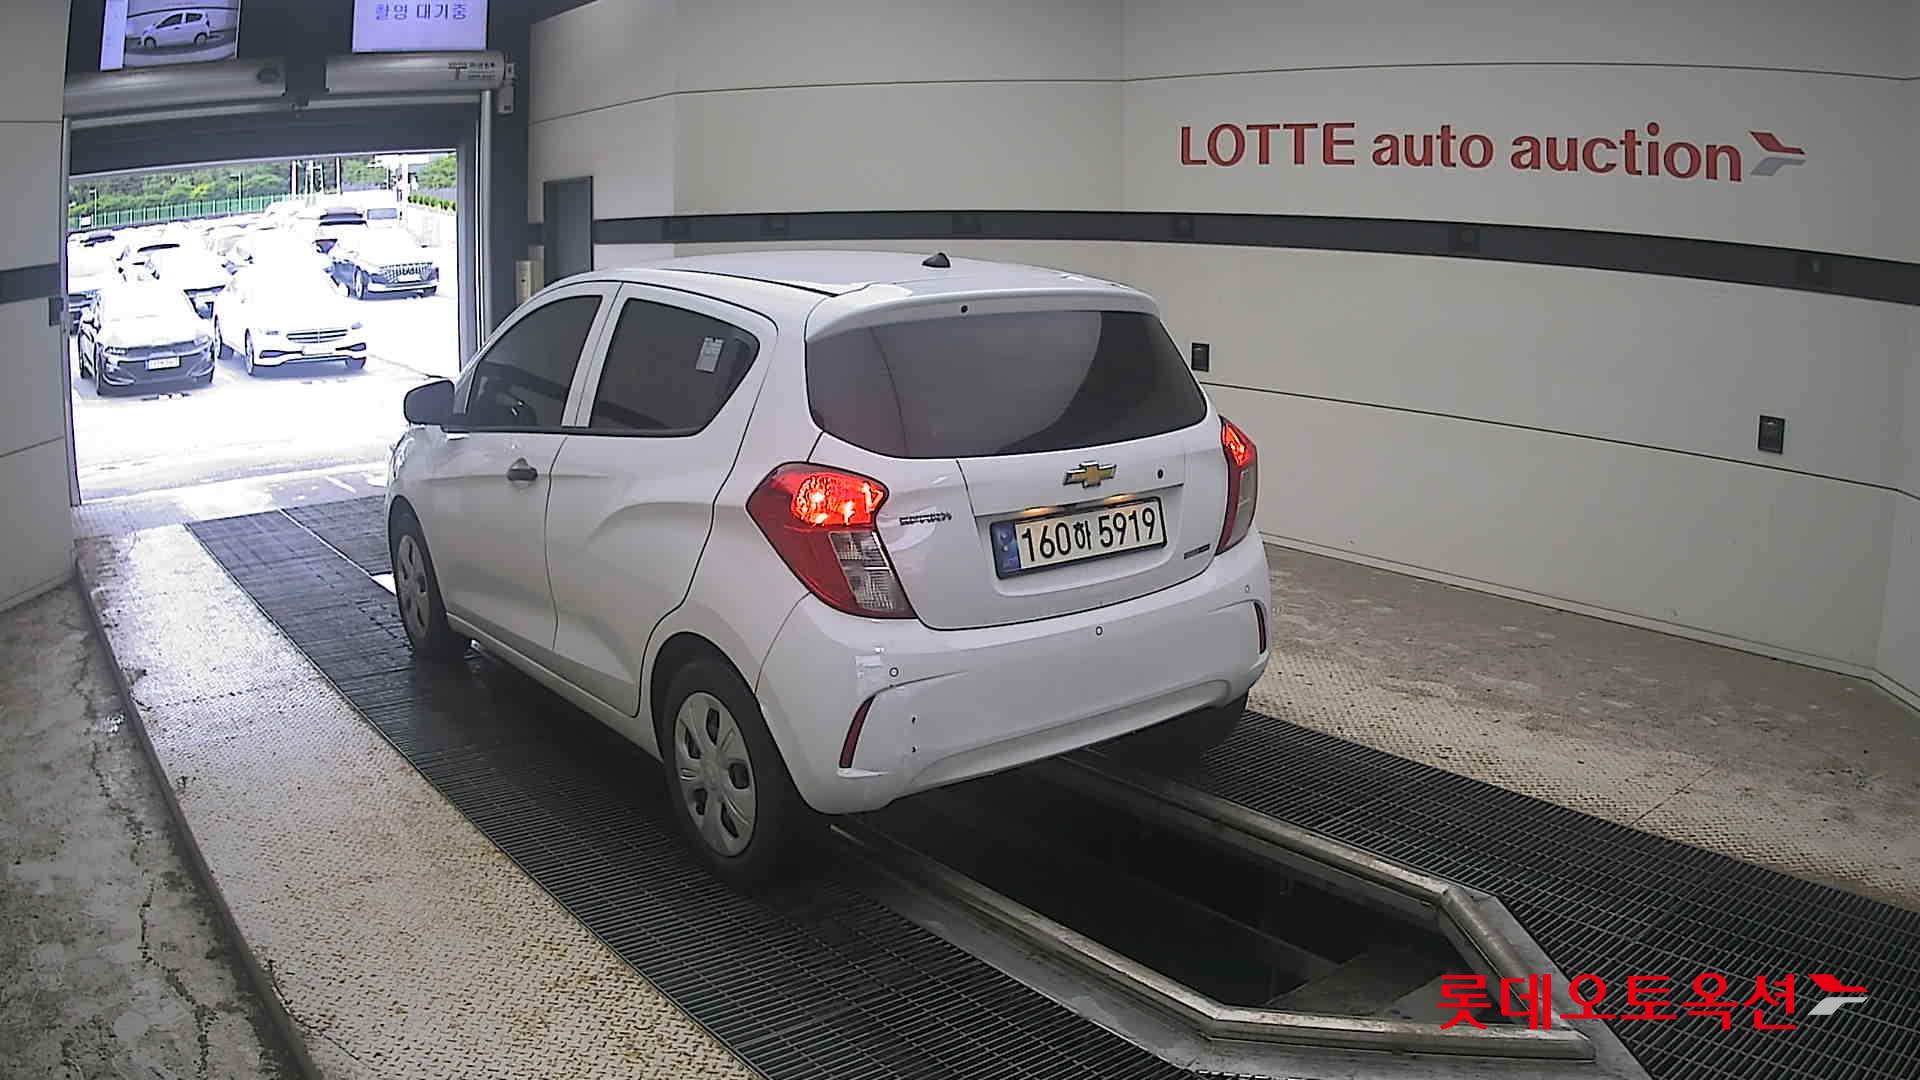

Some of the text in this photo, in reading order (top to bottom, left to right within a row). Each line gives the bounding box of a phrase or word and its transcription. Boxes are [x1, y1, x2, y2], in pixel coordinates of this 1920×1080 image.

[416, 3, 467, 21] 대기중
[1181, 122, 1742, 182] LOTTE auto auction
[1098, 507, 1156, 548] 5919
